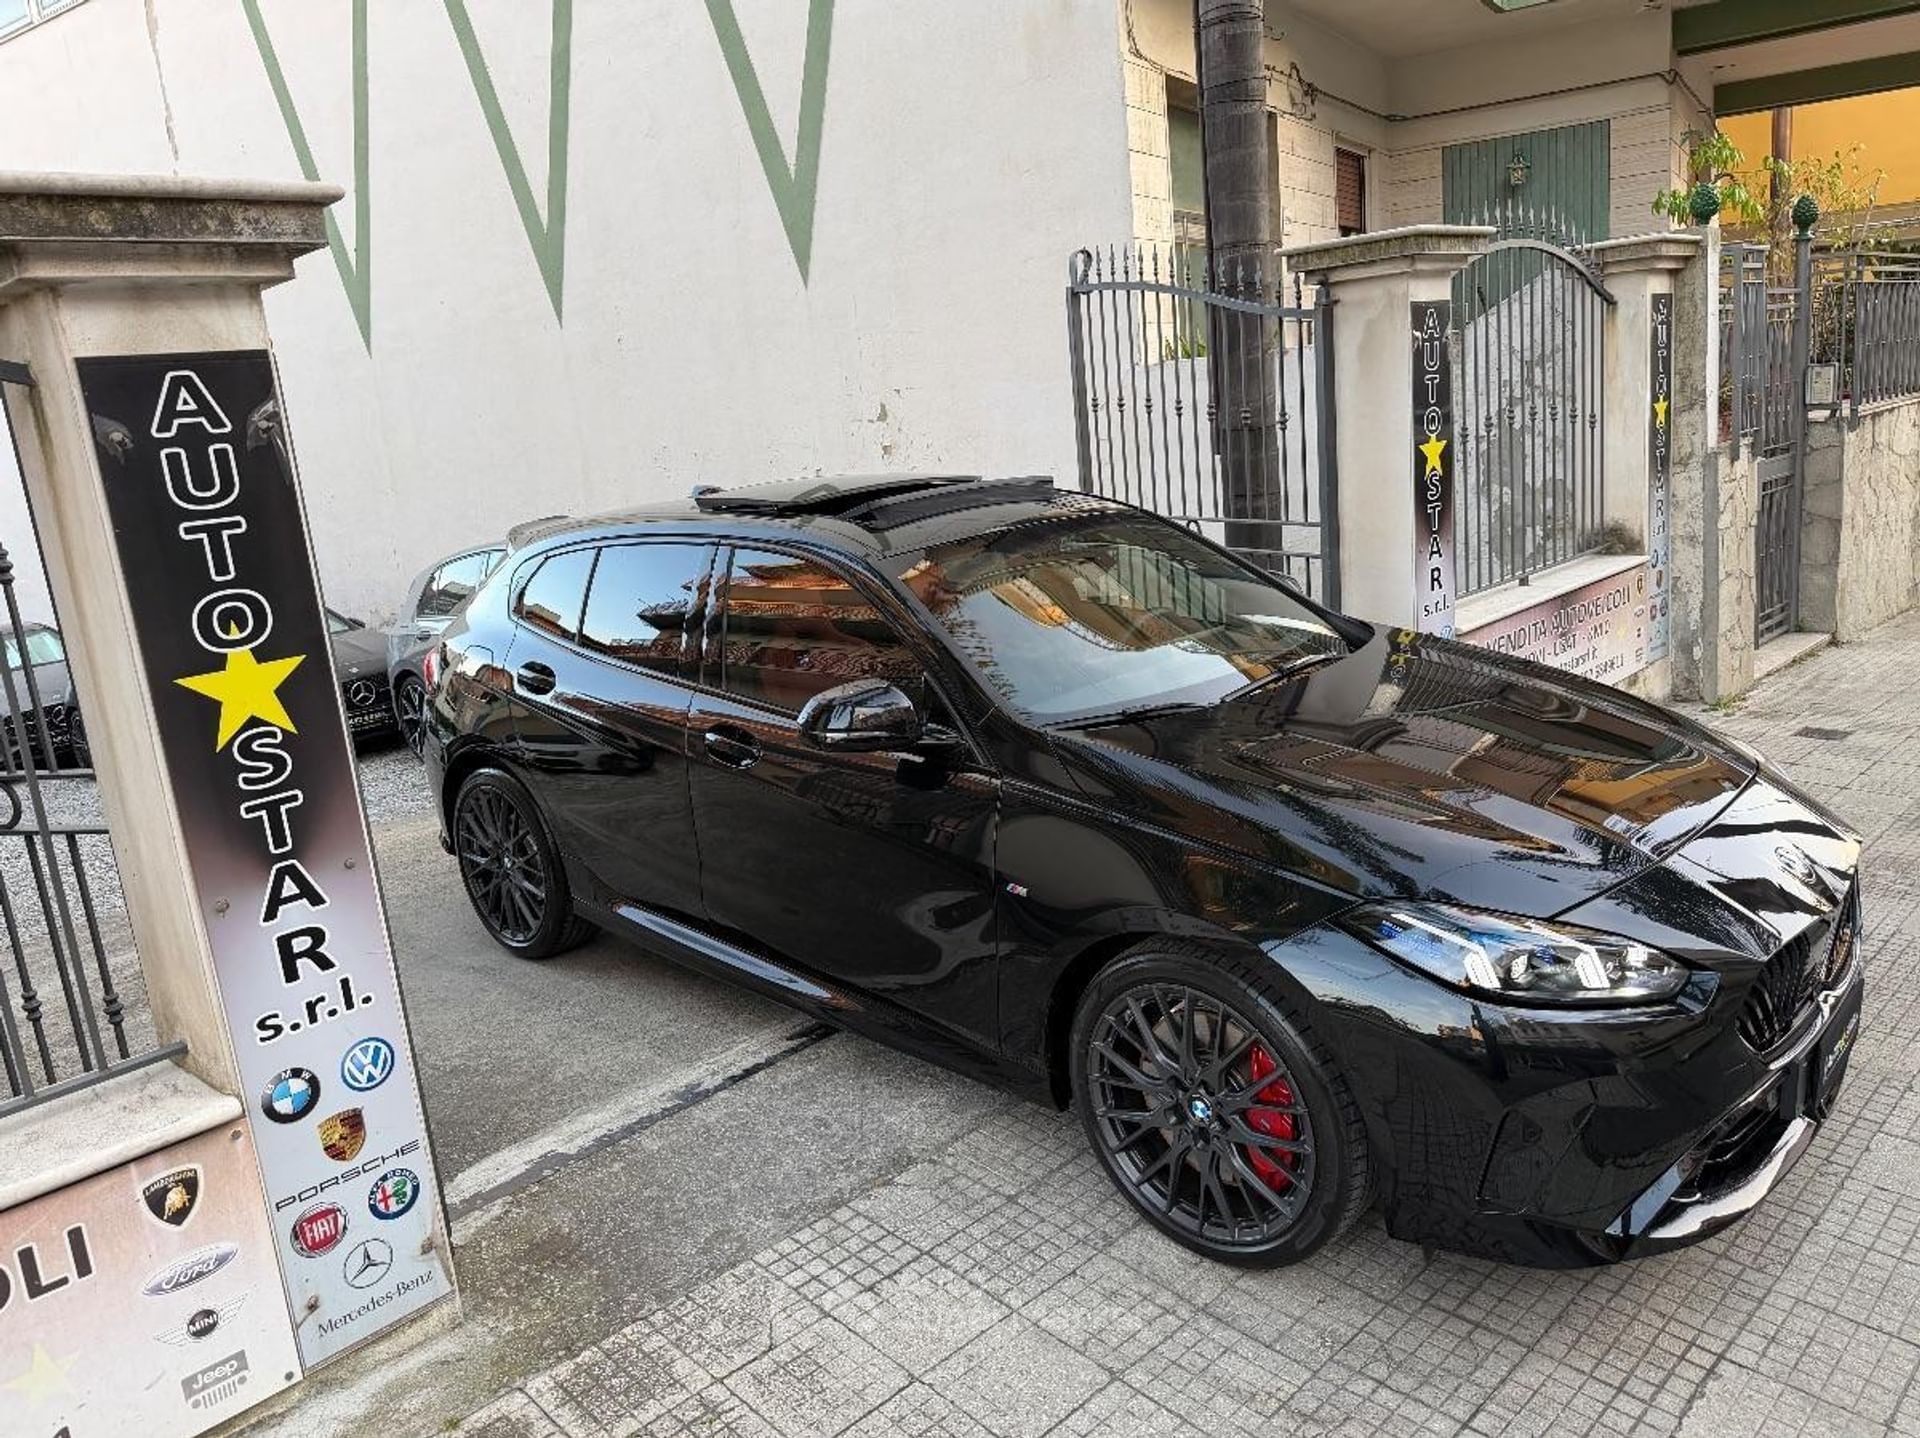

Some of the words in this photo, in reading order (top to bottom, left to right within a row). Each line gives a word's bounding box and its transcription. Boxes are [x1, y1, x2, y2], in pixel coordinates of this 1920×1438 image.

[1423, 309, 1442, 436] AUTO
[1427, 471, 1443, 592] STAR
[1424, 594, 1449, 617] s.r.l.
[151, 370, 273, 654] AUTO
[232, 726, 336, 985] STAR
[254, 975, 373, 1044] s.r.l.
[275, 1139, 420, 1212] PORSCHE
[302, 1212, 336, 1246] FIAT
[162, 1252, 219, 1289] Ford
[318, 1270, 433, 1337] Mercedes-Benz
[188, 1314, 218, 1334] MINI
[192, 1360, 238, 1389] Jeep
